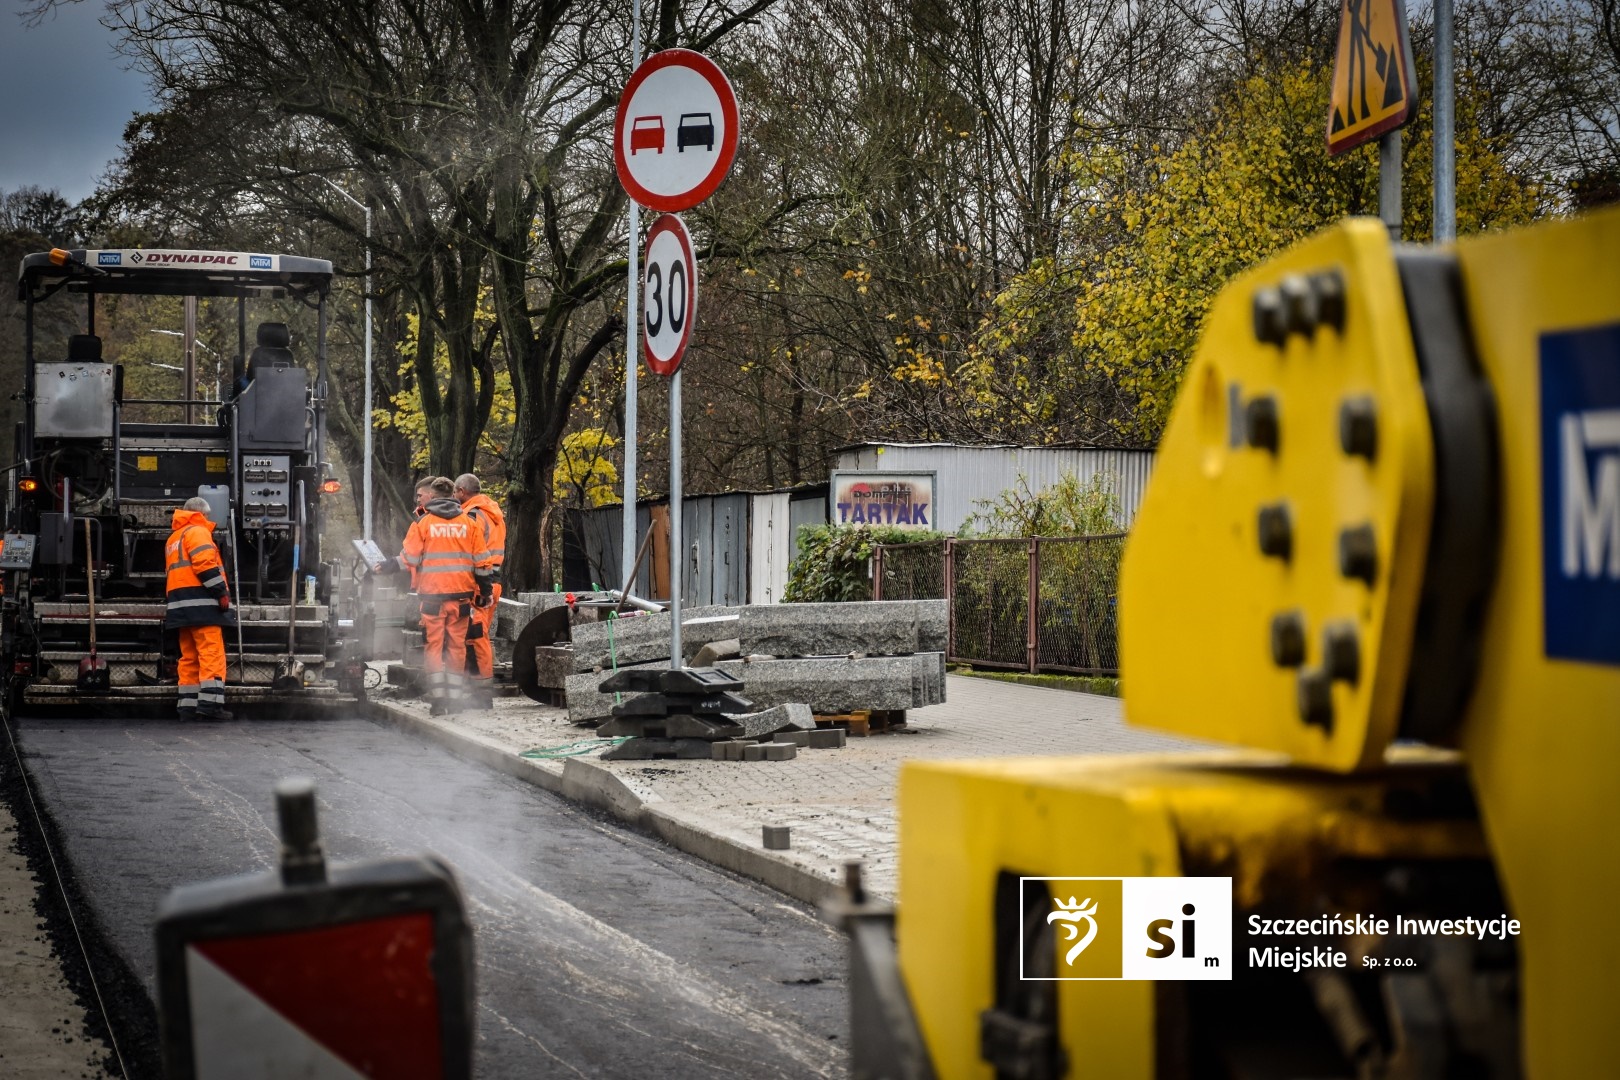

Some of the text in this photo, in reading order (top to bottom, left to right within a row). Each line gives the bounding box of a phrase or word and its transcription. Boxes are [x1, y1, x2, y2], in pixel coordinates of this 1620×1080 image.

[100, 255, 120, 263] MTM
[146, 254, 239, 264] DYNAPAC
[251, 258, 271, 267] MTM
[646, 259, 686, 337] 30
[837, 502, 929, 525] TARTAK
[430, 523, 467, 539] MTM
